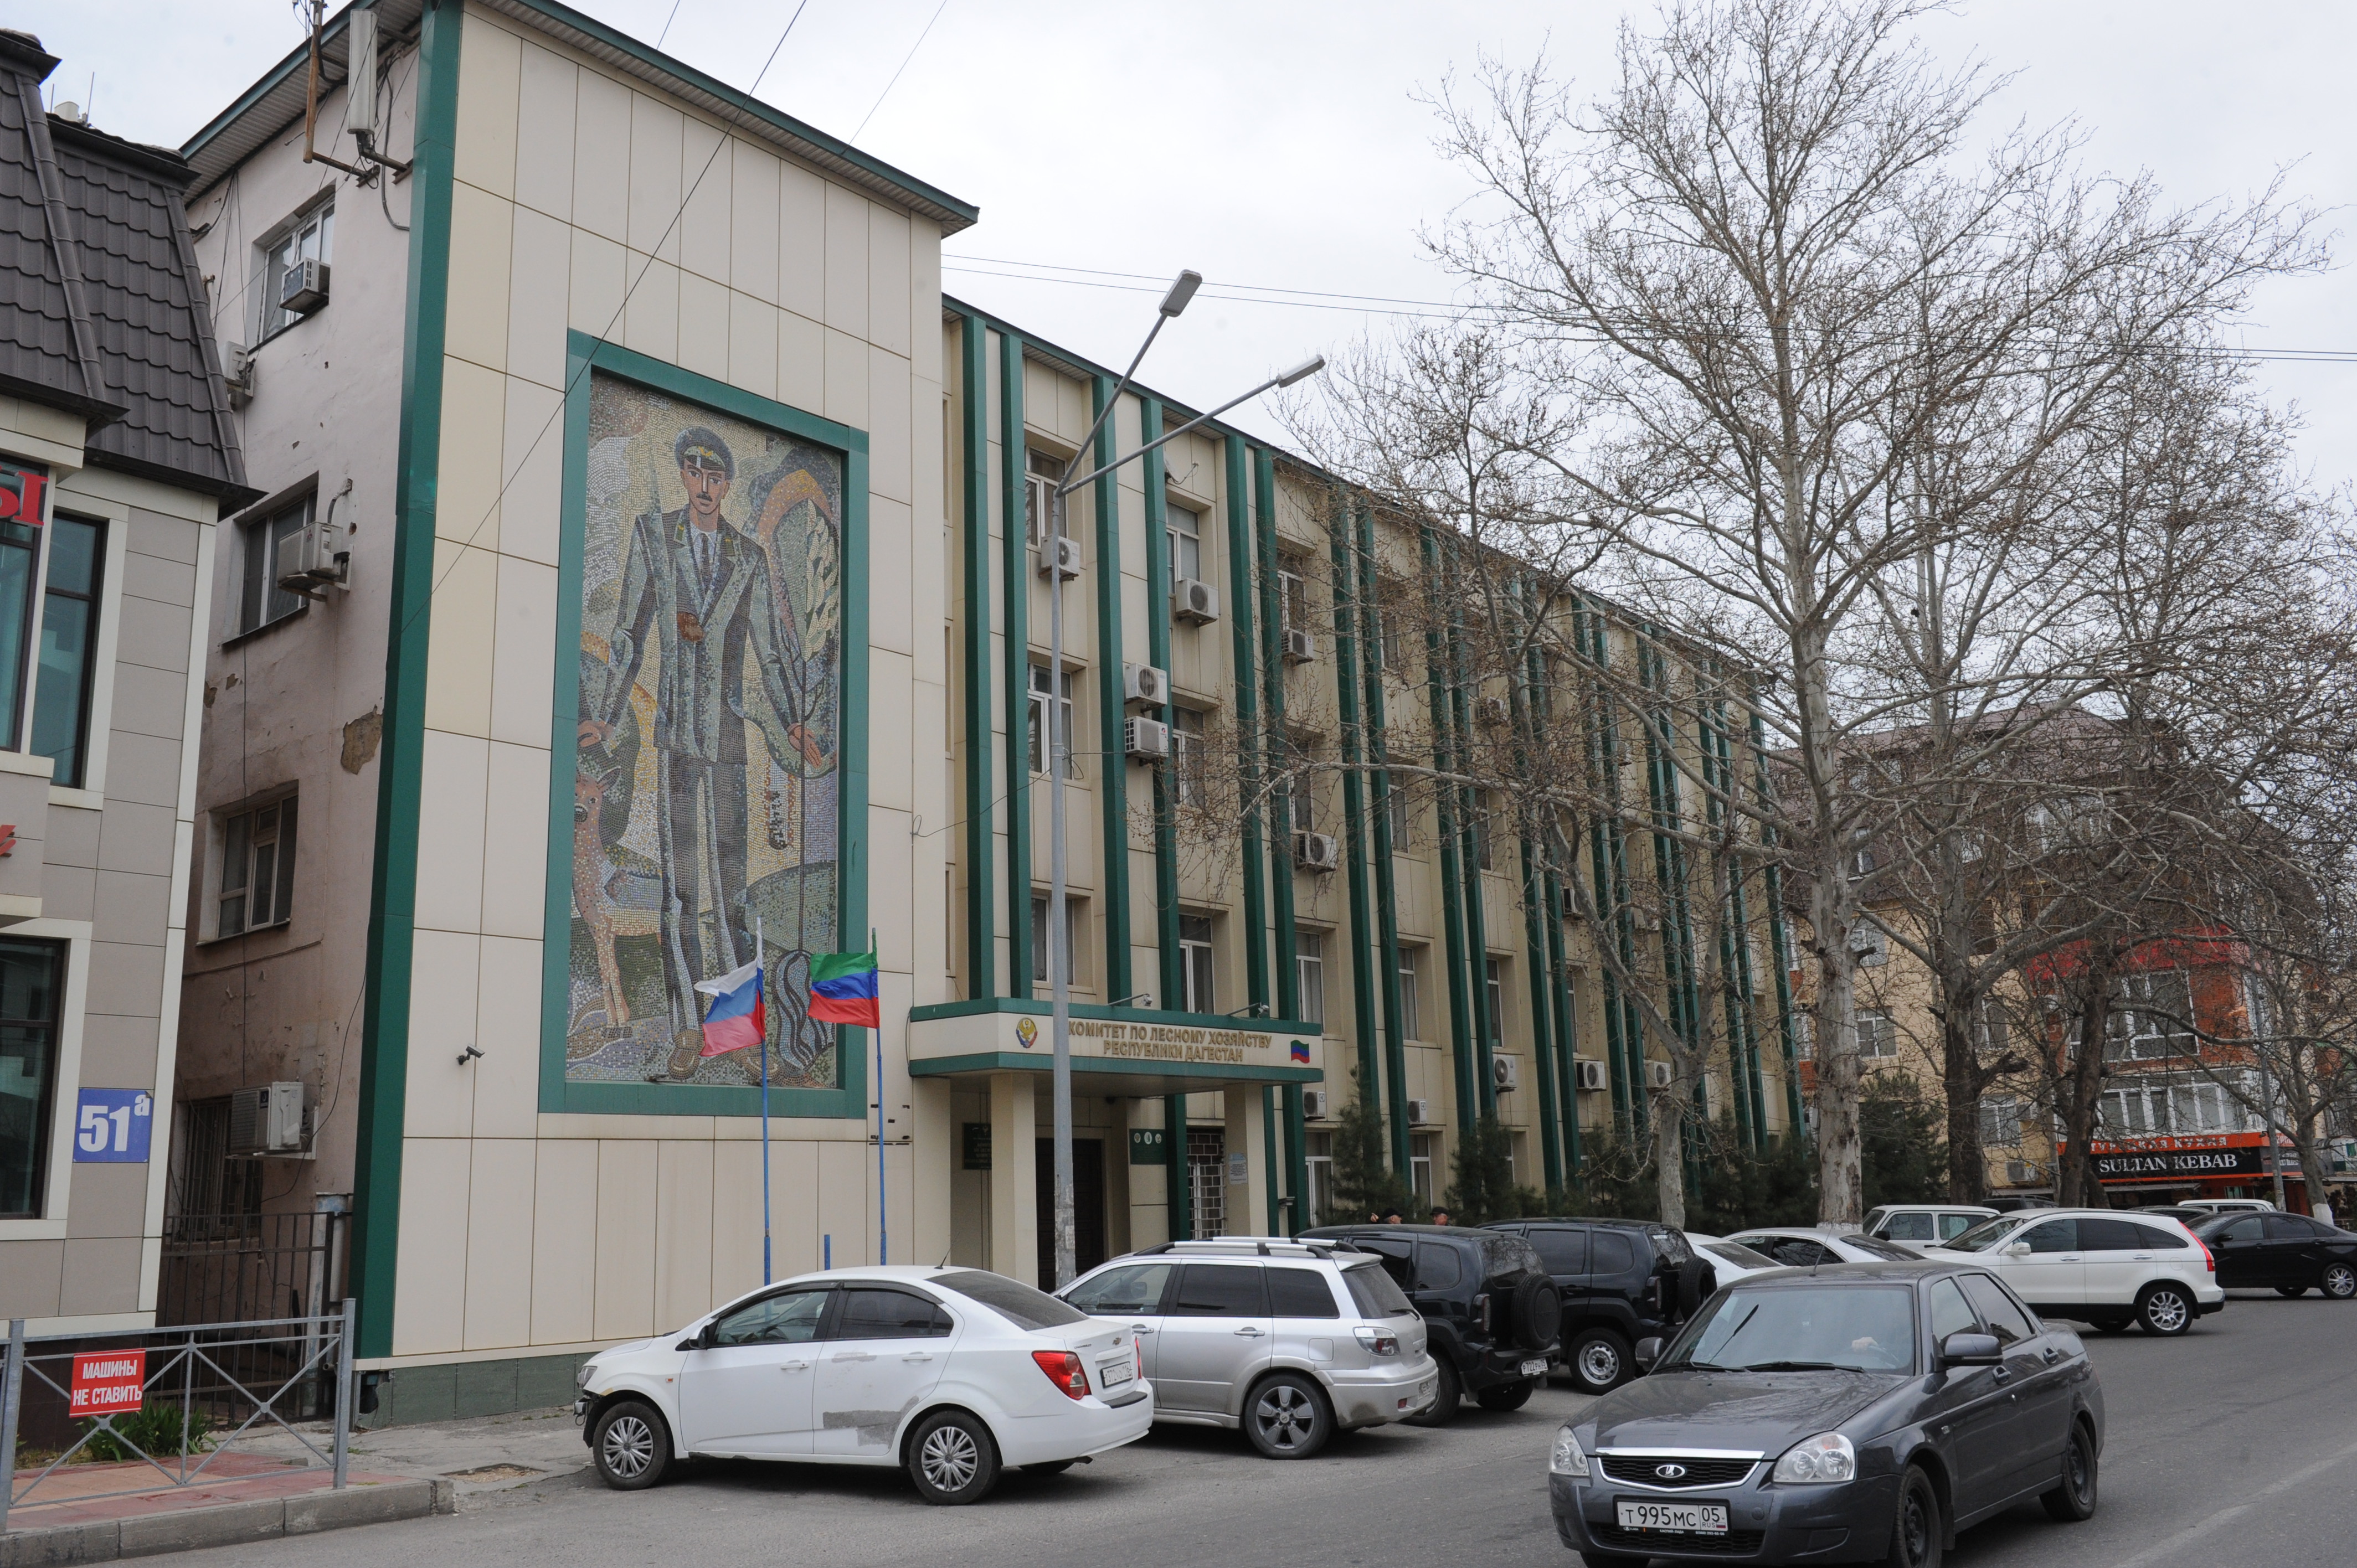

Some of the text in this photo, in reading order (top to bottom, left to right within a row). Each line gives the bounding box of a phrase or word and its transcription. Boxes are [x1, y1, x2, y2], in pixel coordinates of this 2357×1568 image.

[1069, 1021, 1272, 1048] КОМИТЕТ ПО ЛЕСНОМУ ХОЗЯЙСТВУ
[1104, 1040, 1243, 1062] РЕСПУБЛИКИ ДАГЕСТАН
[2099, 1154, 2237, 1173] SULTAN KEBAB
[83, 1359, 137, 1379] МАШИНЫ
[73, 1385, 142, 1406] НЕ СТАВИТЬ
[1702, 1507, 1720, 1522] 05
